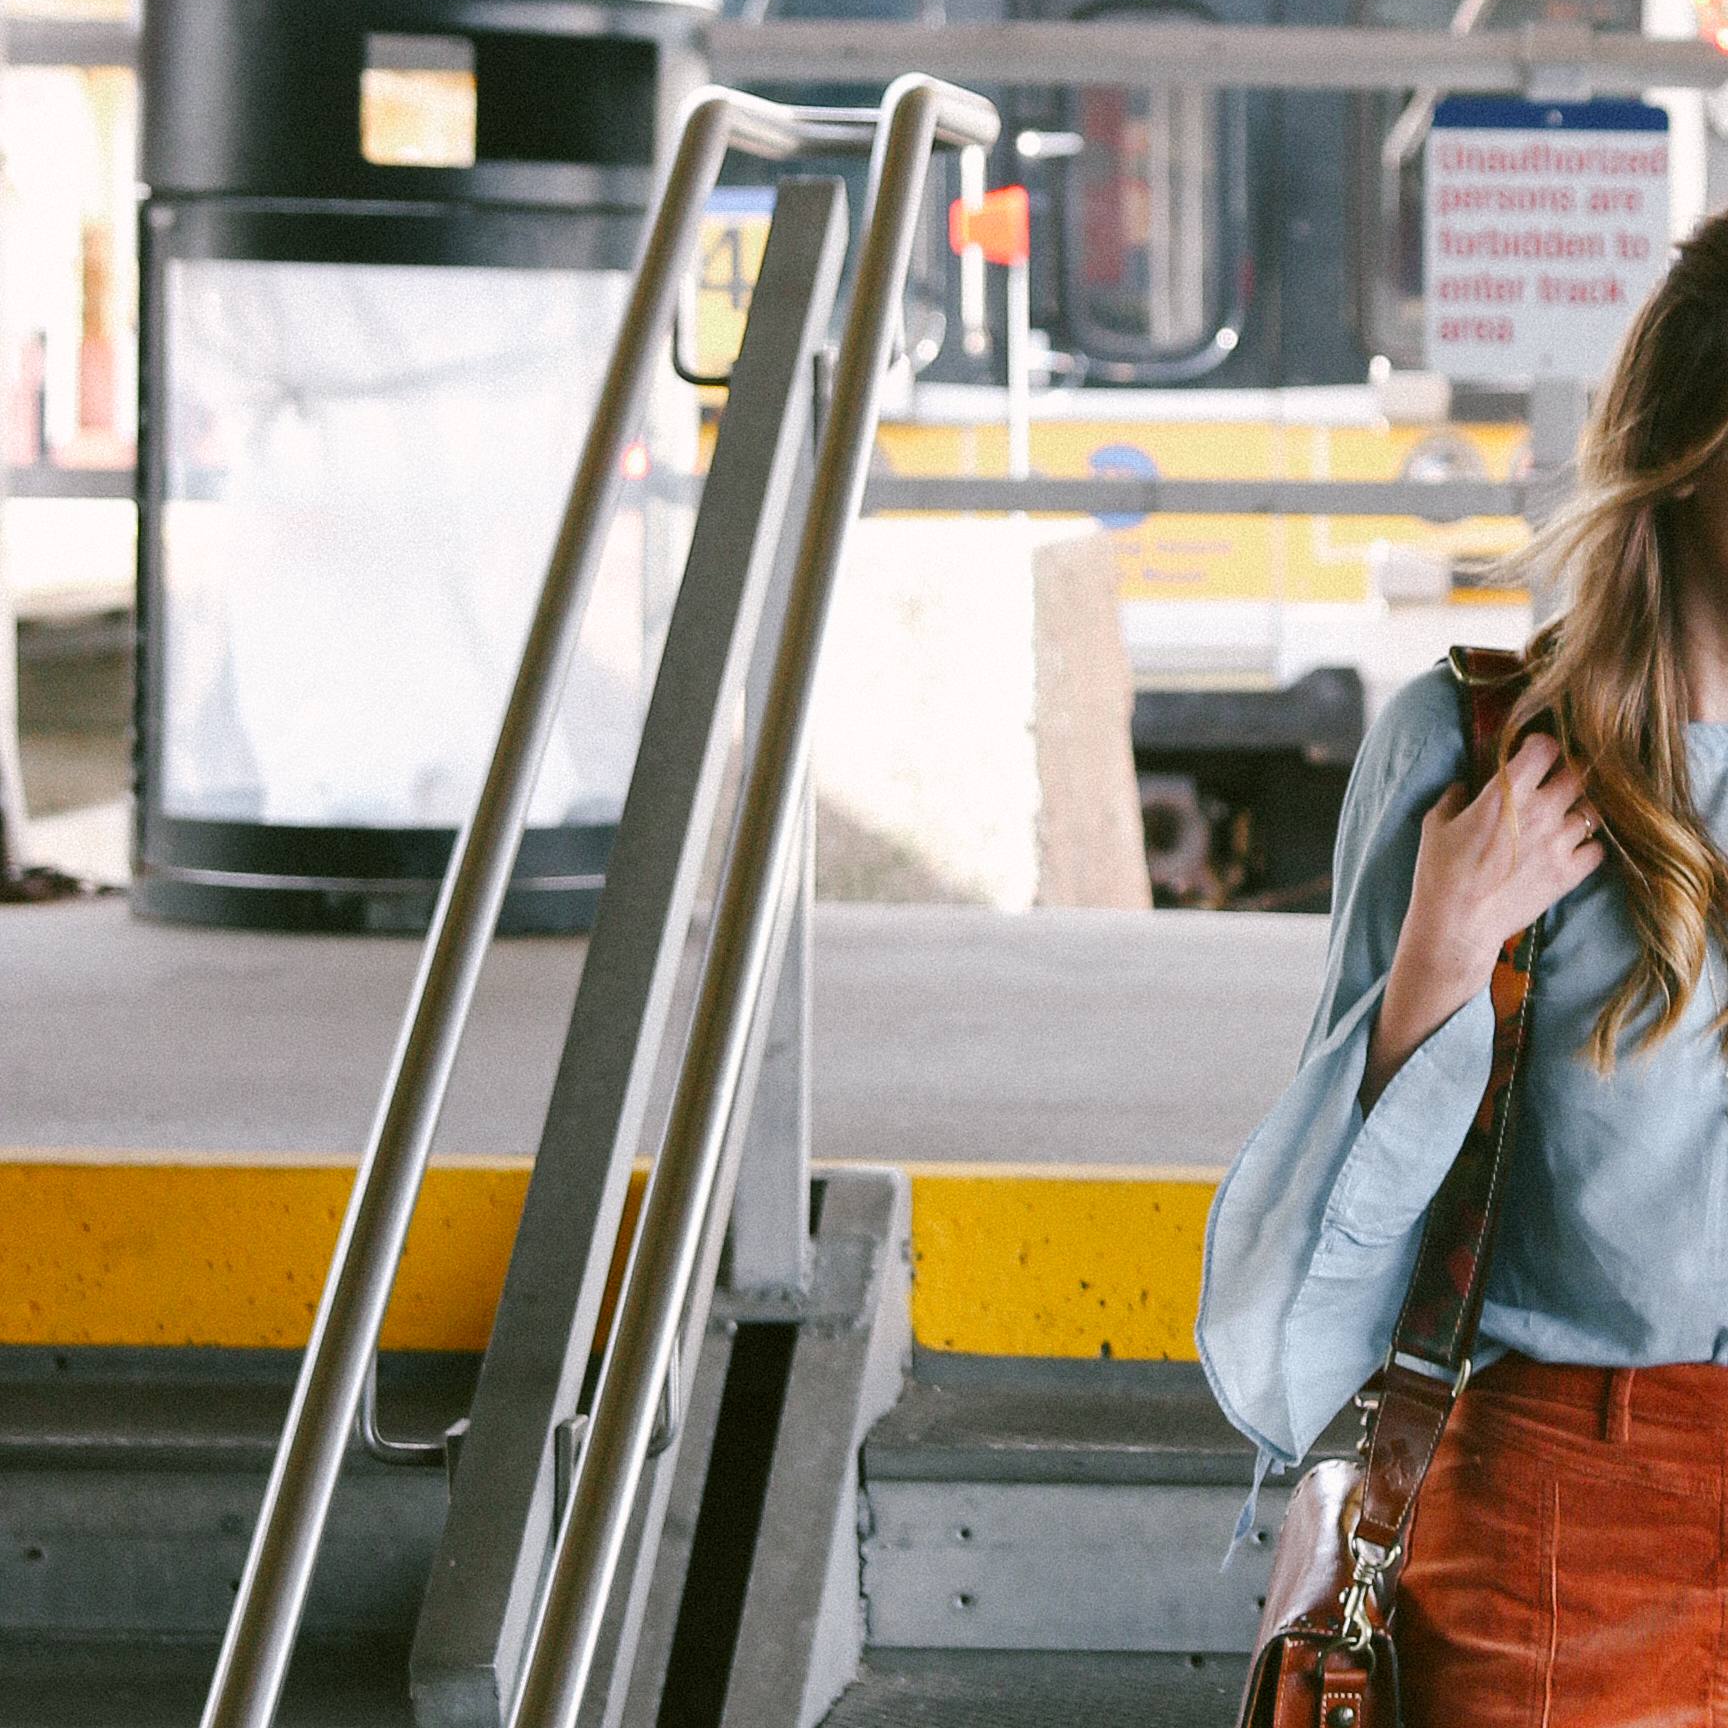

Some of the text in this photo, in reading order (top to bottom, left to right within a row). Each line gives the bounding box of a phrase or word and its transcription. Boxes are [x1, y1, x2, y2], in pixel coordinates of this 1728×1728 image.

[1439, 143, 1667, 176] Unauthorized
[1438, 186, 1643, 215] persons are
[1439, 228, 1650, 259] forbidden to
[1439, 272, 1626, 304] enter track
[1438, 316, 1514, 342] area
